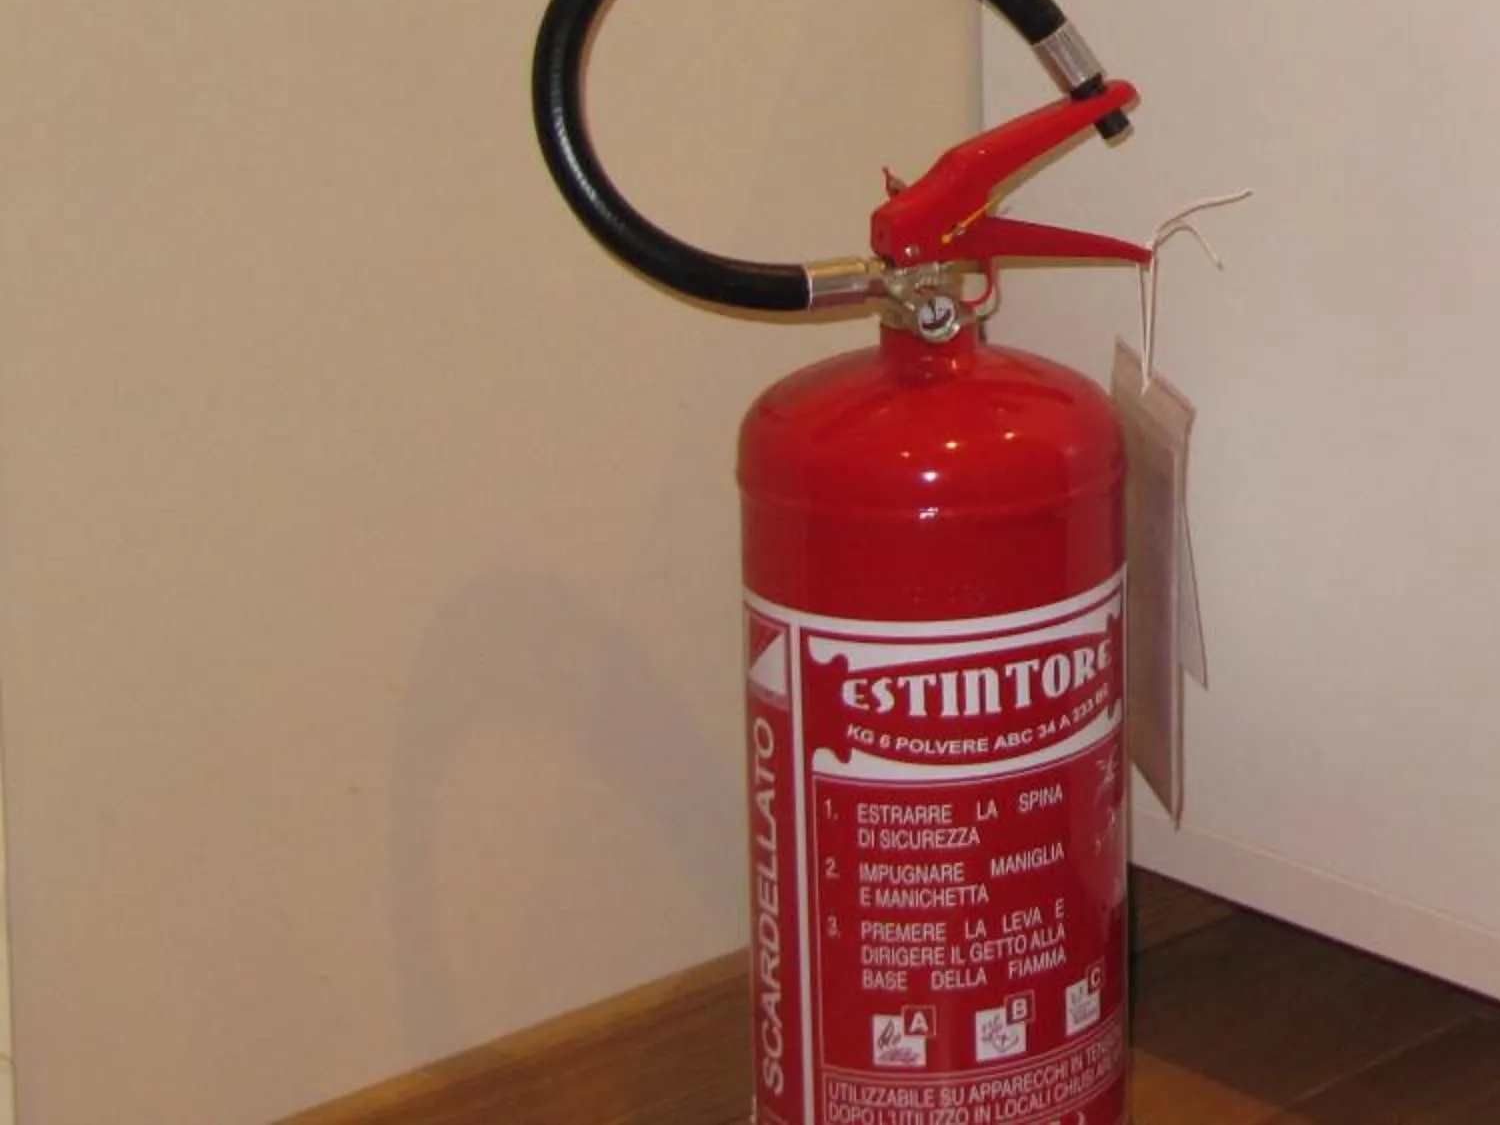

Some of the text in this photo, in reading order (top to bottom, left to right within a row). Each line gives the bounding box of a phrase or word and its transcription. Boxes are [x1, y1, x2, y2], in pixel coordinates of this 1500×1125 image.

[841, 638, 1111, 716] ESTINTORE
[847, 724, 874, 743] KG
[879, 734, 891, 749] 6
[895, 735, 989, 755] POLVERE
[994, 726, 1033, 749] ABC
[1038, 719, 1056, 738] 34
[1058, 716, 1072, 730] A
[824, 783, 1064, 824] 1. ESTRARRE LA SPINA
[858, 826, 981, 850] DI SICUREZZA
[859, 862, 965, 884] IMPUGNARE
[990, 842, 1065, 878] MANIGLIA
[753, 715, 785, 1094] SCARDELLATO
[860, 884, 989, 908] E MANICHETTA
[861, 921, 947, 942] PREMERE
[965, 918, 987, 940] LA
[1003, 906, 1043, 933] LEVA
[1055, 898, 1065, 919] E
[861, 924, 1066, 966] DIRIGERE IL GETTO ALLA
[862, 947, 1067, 991] BASE DELLA FIAMMA
[1089, 968, 1101, 989] C
[909, 1011, 929, 1033] A
[1012, 997, 1027, 1020] B
[828, 1081, 935, 1108] UTILIZZABILE
[940, 1087, 965, 1107] SU
[969, 1059, 1068, 1102] APPARECCHI
[1071, 1053, 1083, 1074] IN
[828, 1104, 873, 1123] DOPO
[973, 1103, 992, 1123] IN
[995, 1084, 1052, 1120] LOCALI
